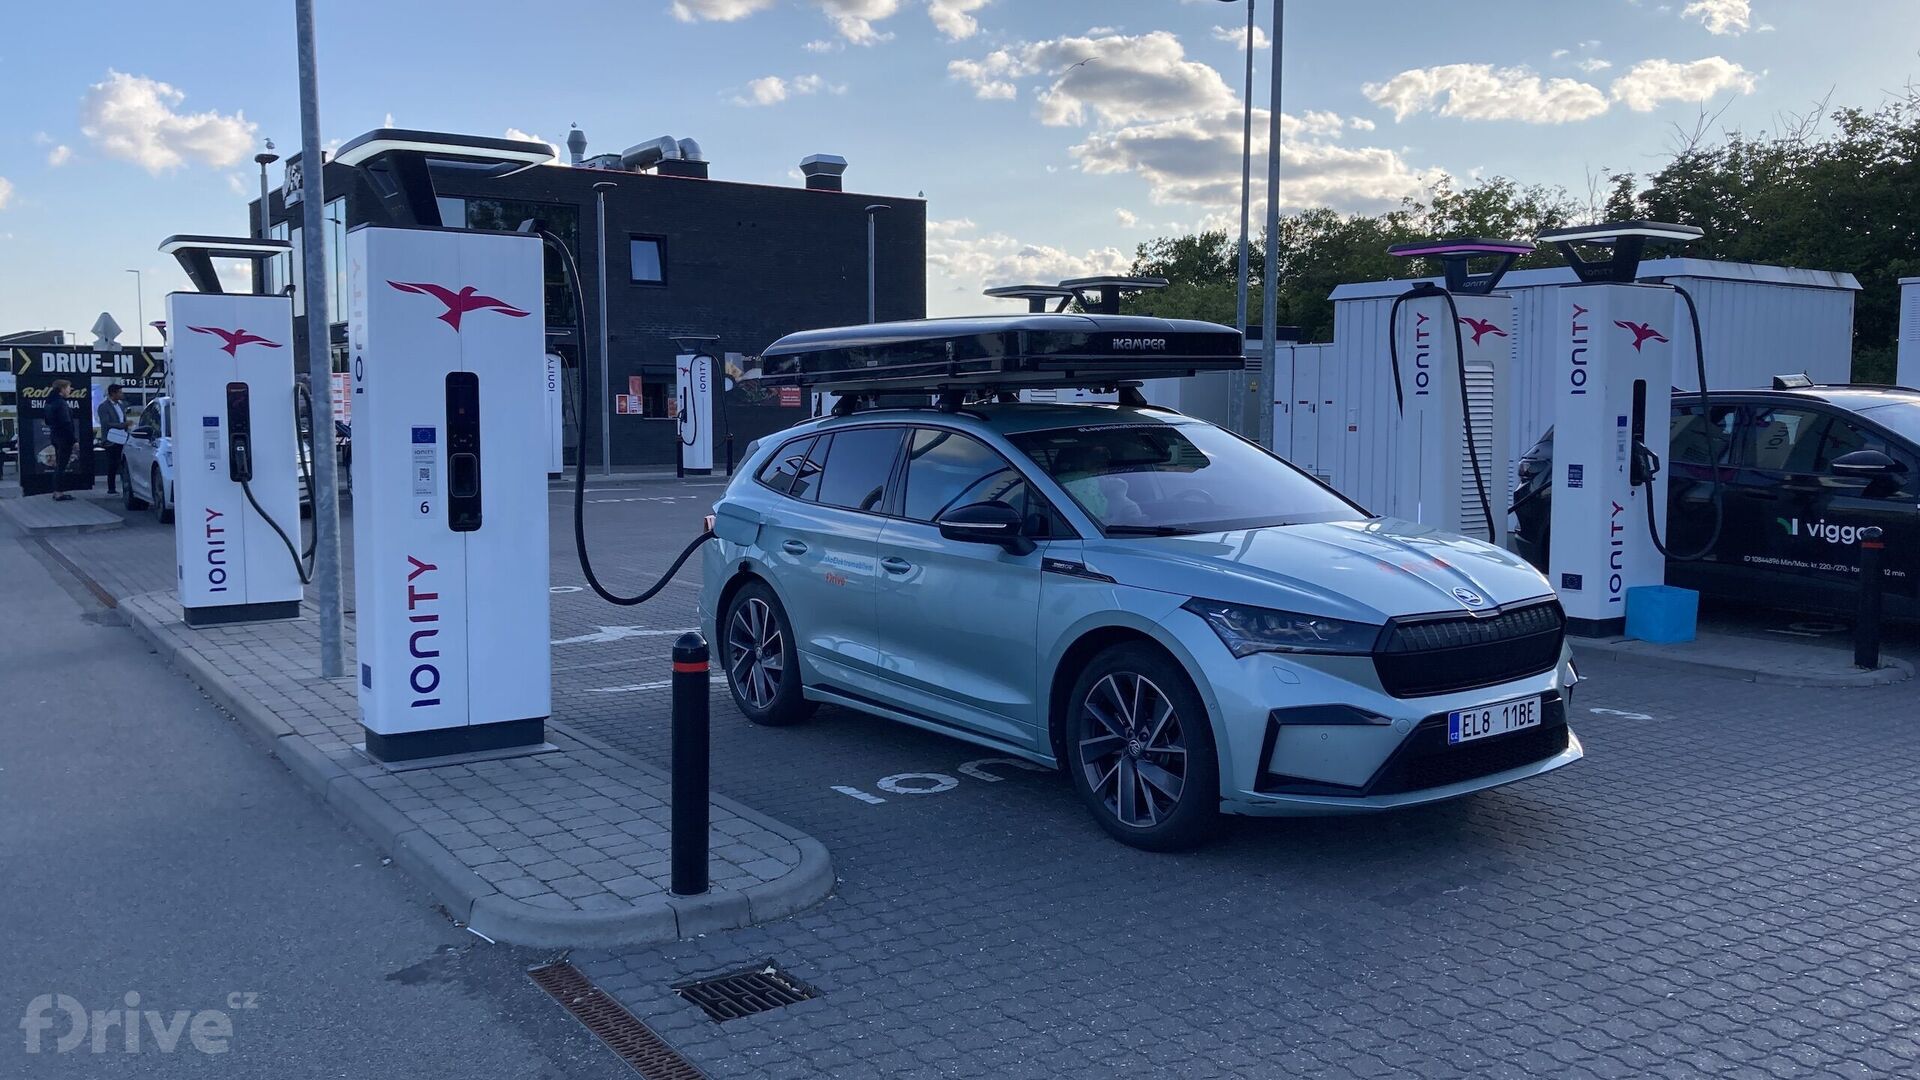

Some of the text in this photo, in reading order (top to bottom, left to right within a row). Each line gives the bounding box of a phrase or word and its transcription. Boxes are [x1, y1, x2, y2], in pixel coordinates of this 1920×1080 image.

[42, 352, 134, 374] DRIVE-IN
[1415, 312, 1430, 396] IONITY
[1570, 303, 1589, 395] IONITY
[547, 358, 555, 392] IONITY
[209, 462, 216, 471] 5
[420, 501, 430, 514] 6
[205, 508, 227, 592] IONITY
[1608, 500, 1625, 603] IONITY
[1892, 569, 1906, 577] min
[407, 555, 441, 708] IONITY
[1462, 701, 1535, 738] EL8 11BE
